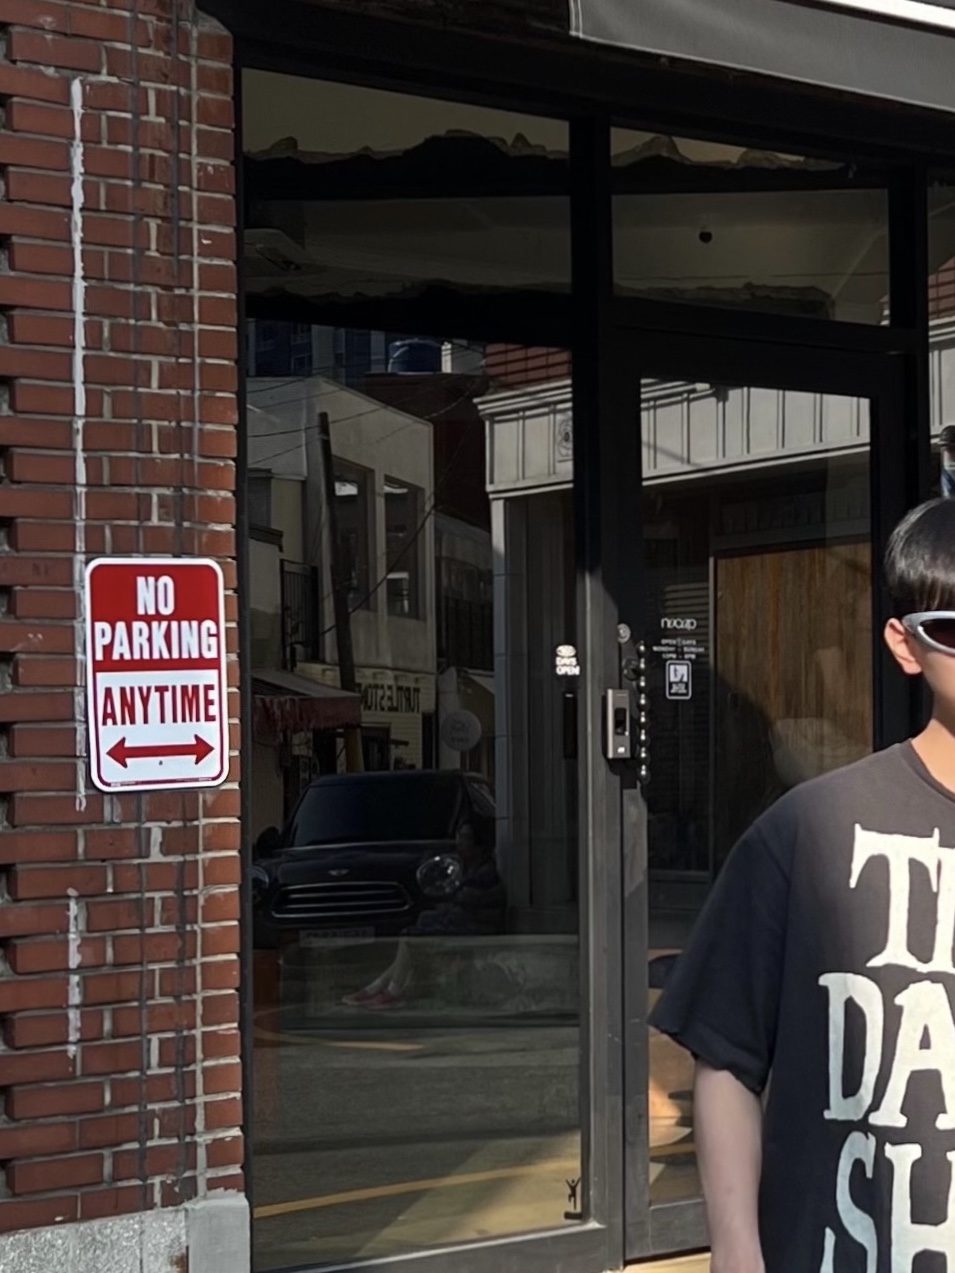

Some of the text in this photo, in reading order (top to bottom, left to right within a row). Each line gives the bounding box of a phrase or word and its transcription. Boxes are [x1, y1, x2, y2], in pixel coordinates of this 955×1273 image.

[136, 575, 175, 616] NO
[94, 619, 218, 661] PARKING
[102, 684, 216, 726] ANYTIME
